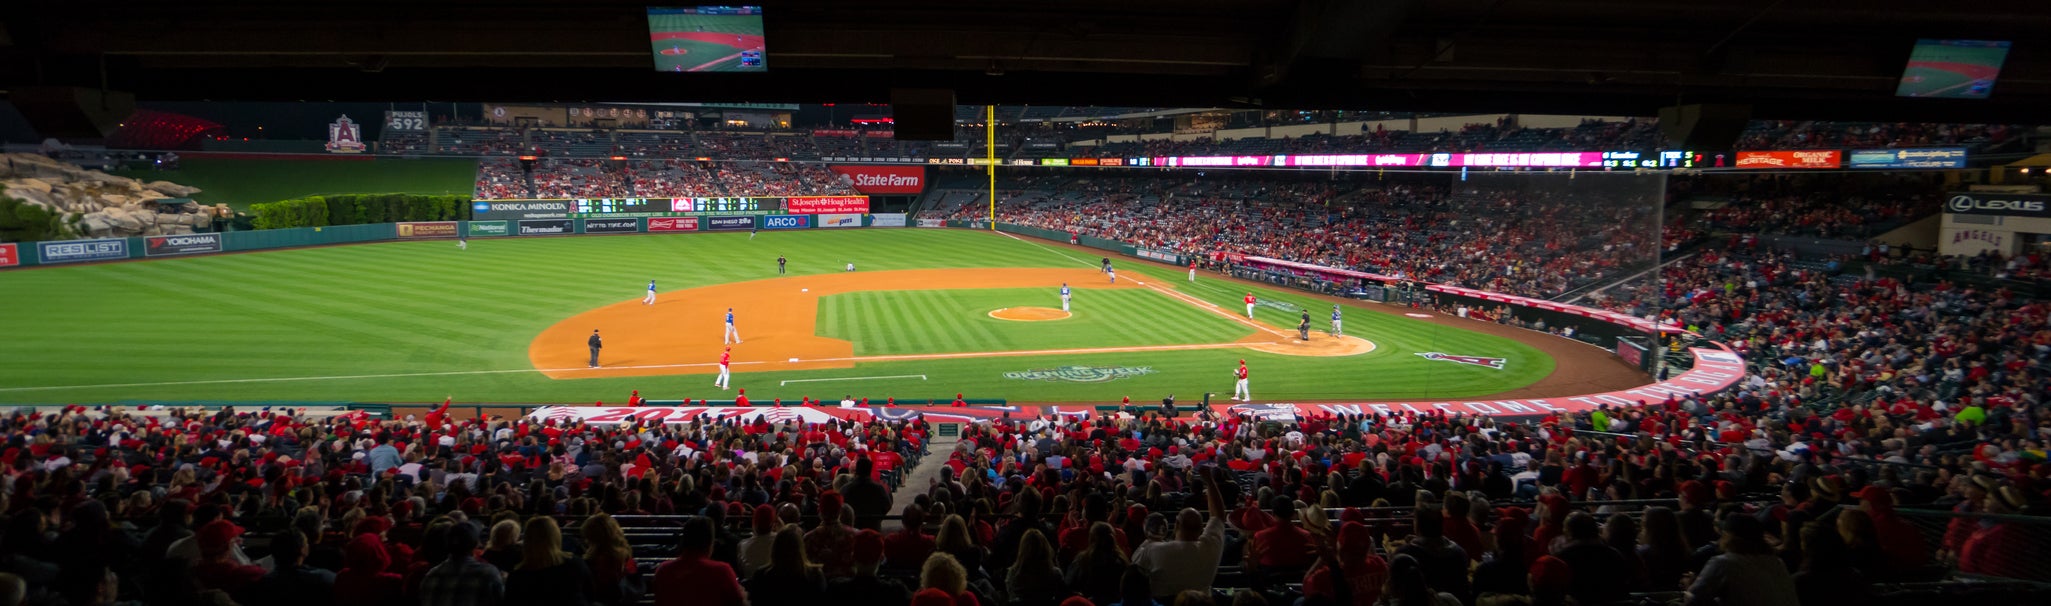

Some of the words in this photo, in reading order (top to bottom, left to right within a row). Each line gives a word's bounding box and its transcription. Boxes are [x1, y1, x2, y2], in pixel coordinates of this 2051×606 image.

[393, 119, 424, 130] 592
[1736, 157, 1784, 166] HERITAGE
[856, 173, 886, 186] State
[887, 174, 919, 186] Farm
[492, 203, 526, 211] KONICA
[528, 202, 566, 210] MINOLTA
[828, 198, 844, 206] Hoag
[1975, 199, 2045, 211] LEXUS
[768, 217, 796, 226] ARCO
[167, 236, 215, 246] YOKOHAMA
[1953, 230, 2003, 247] ANGELS
[1099, 366, 1152, 377] WEEK
[1317, 399, 1568, 417] WELCOME
[1569, 395, 1630, 407] TO
[1626, 382, 1703, 400] THE
[1680, 369, 1735, 386] BIG
[585, 408, 757, 422] 2017
